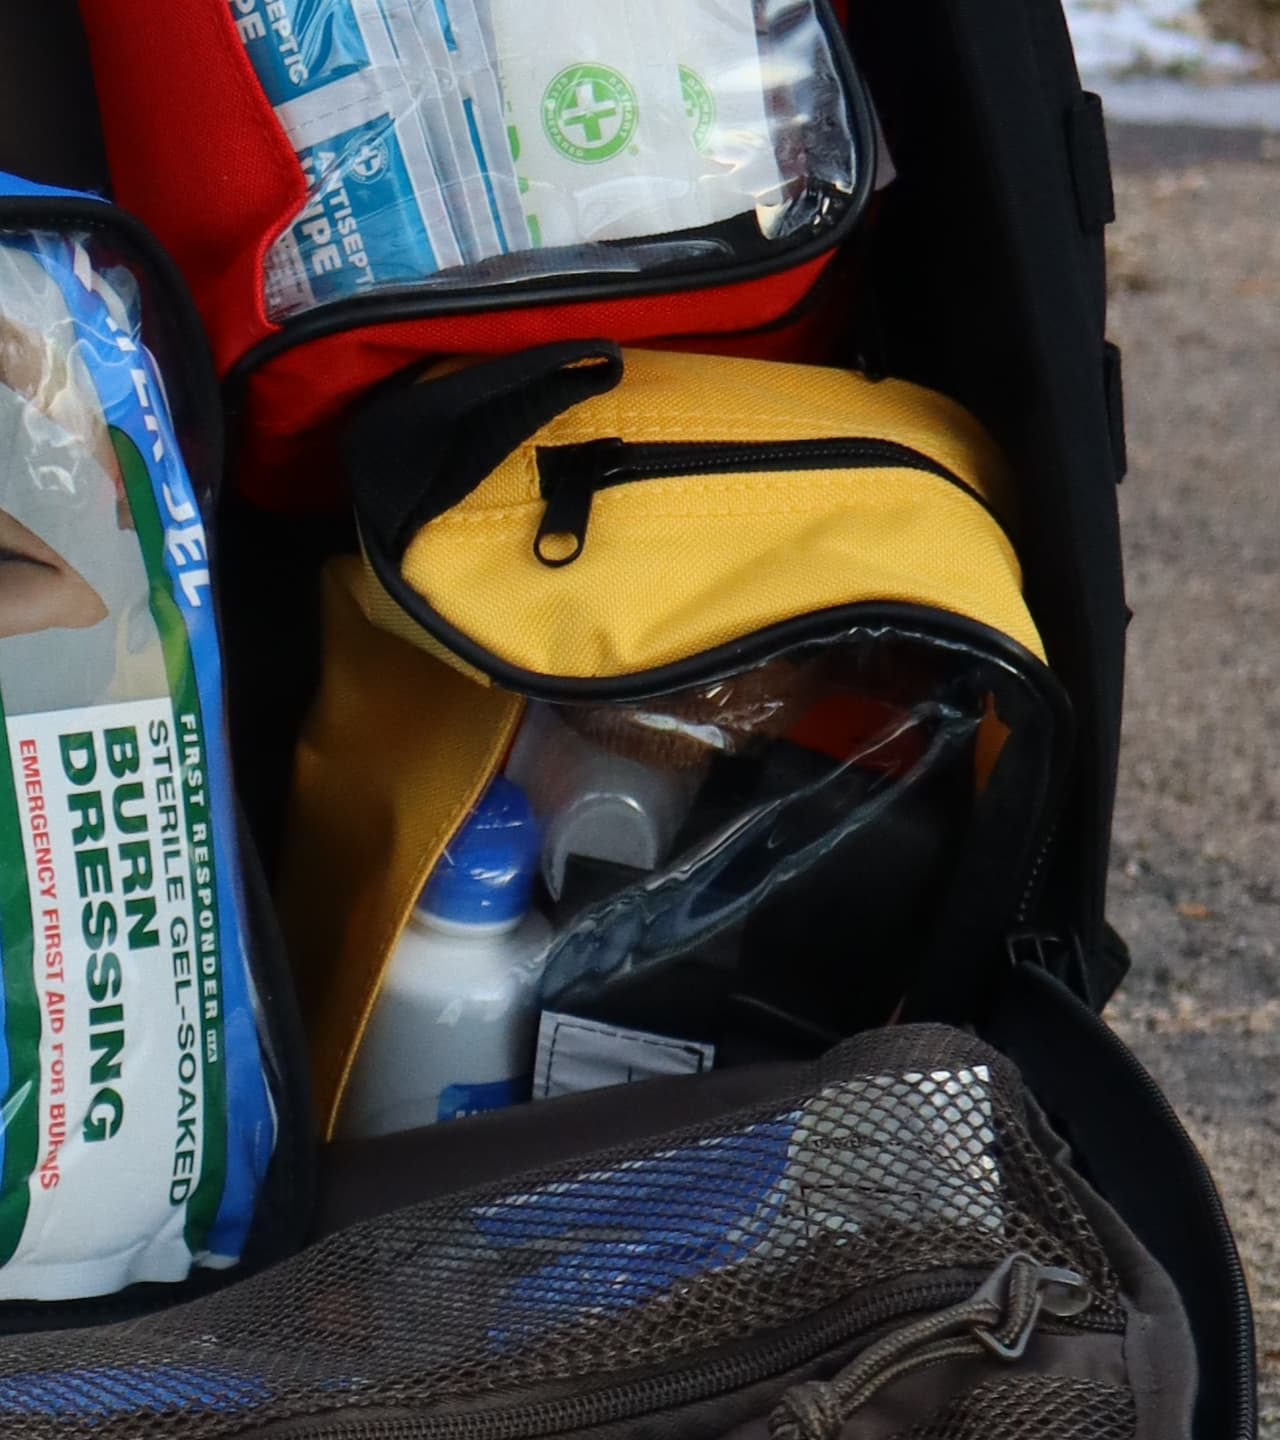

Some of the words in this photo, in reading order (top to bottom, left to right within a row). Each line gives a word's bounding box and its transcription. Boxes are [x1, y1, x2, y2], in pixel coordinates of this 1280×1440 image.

[162, 483, 211, 608] JEL
[19, 739, 57, 901] EMERGENCY
[103, 725, 161, 950] BURN
[180, 713, 204, 807] FIRST
[192, 822, 218, 1019] RESPONDER
[42, 908, 64, 982] FIRST
[45, 990, 65, 1035] AID
[58, 731, 126, 1144] DRESSING
[149, 719, 186, 903] STERILE
[169, 916, 197, 1207] GEL-SOAKED
